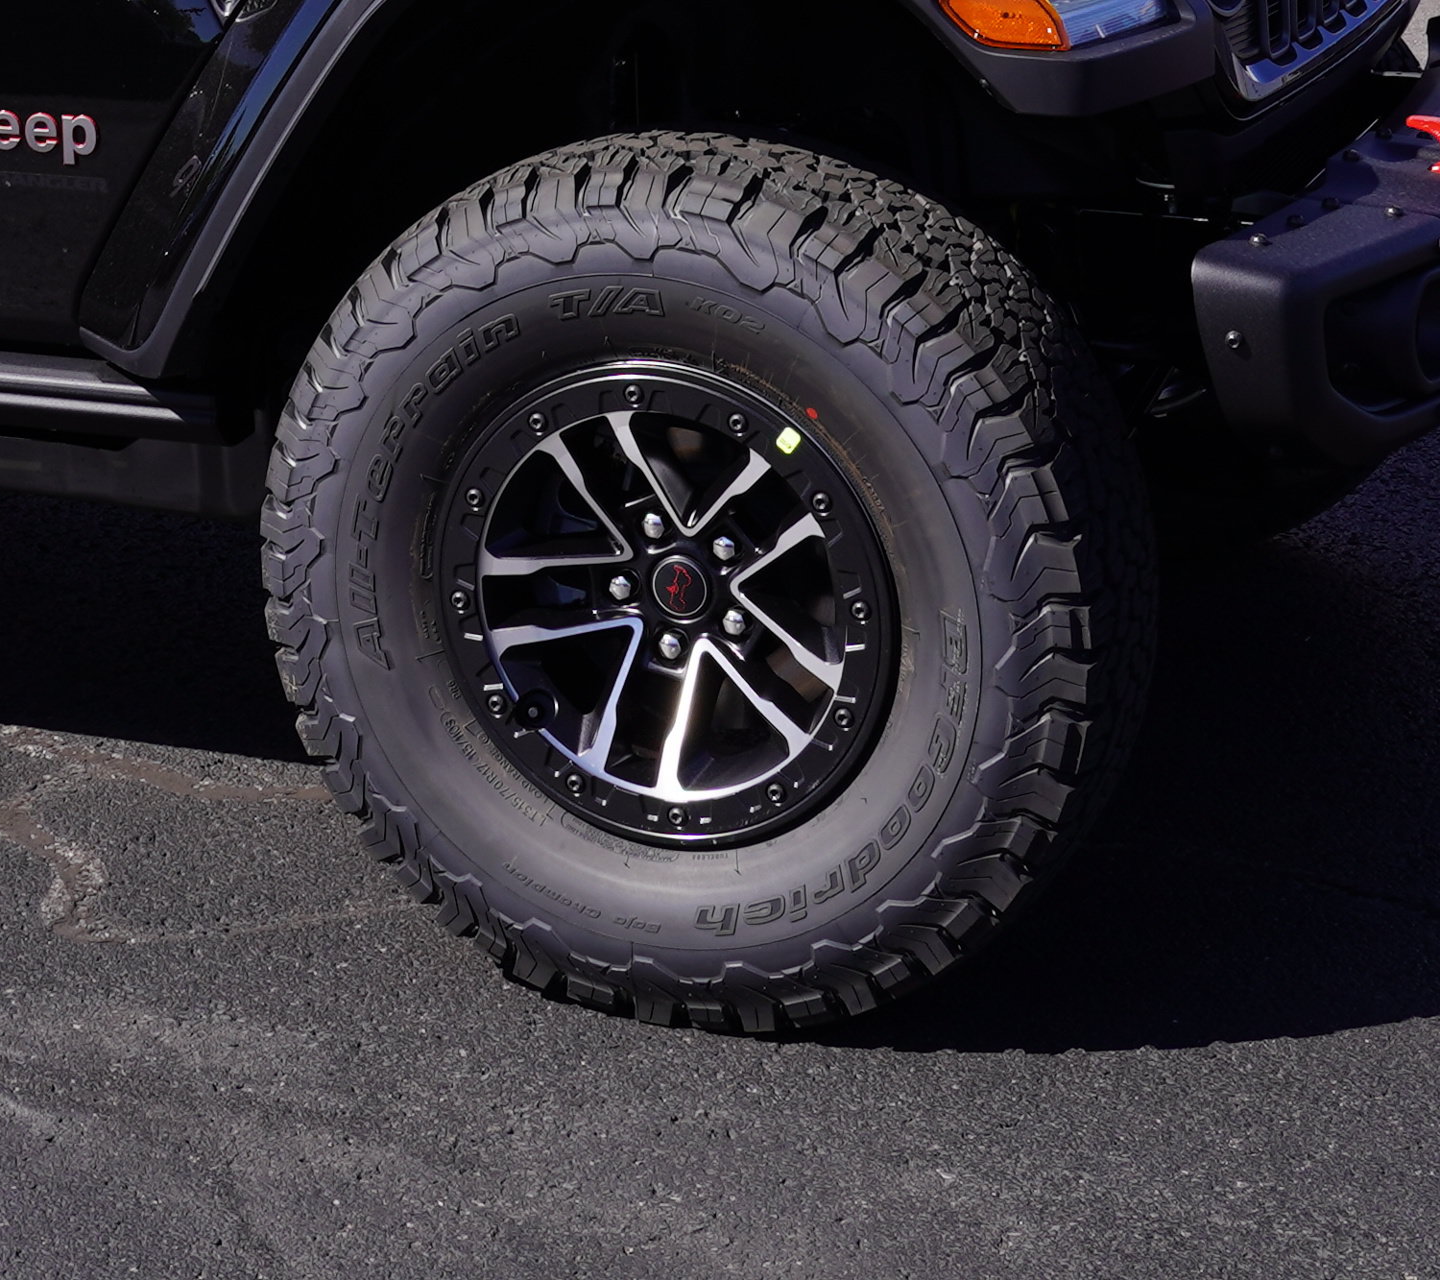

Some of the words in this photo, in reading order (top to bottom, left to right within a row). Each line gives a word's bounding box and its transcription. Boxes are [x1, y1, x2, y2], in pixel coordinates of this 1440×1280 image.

[347, 311, 521, 671] All-Terrain
[547, 284, 666, 322] T/A
[687, 295, 766, 335] KO2
[692, 607, 969, 937] BFGoodrich
